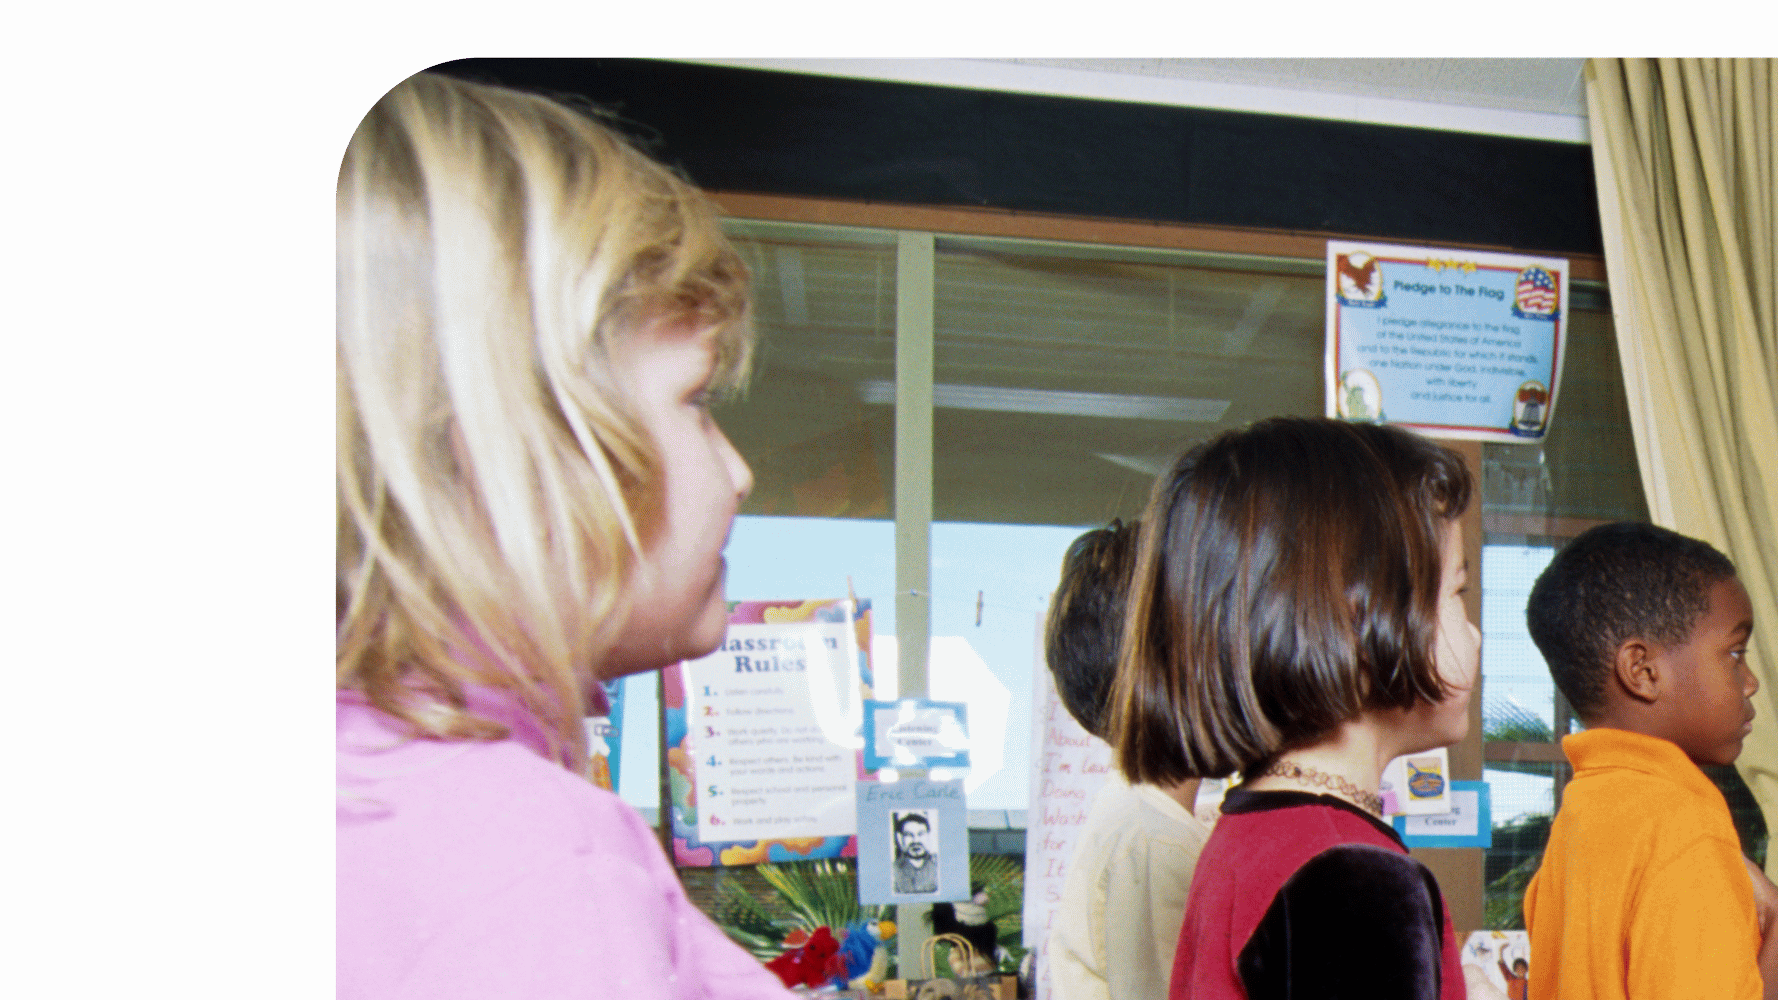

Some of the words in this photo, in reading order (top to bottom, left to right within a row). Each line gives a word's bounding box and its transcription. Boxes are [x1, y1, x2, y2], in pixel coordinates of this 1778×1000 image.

[1393, 280, 1437, 296] Pledge
[1439, 284, 1452, 295] to
[1455, 284, 1476, 297] The
[1478, 286, 1505, 302] Flag
[734, 656, 807, 673] Rules
[865, 784, 905, 802] Eric
[913, 780, 962, 800] Carle
